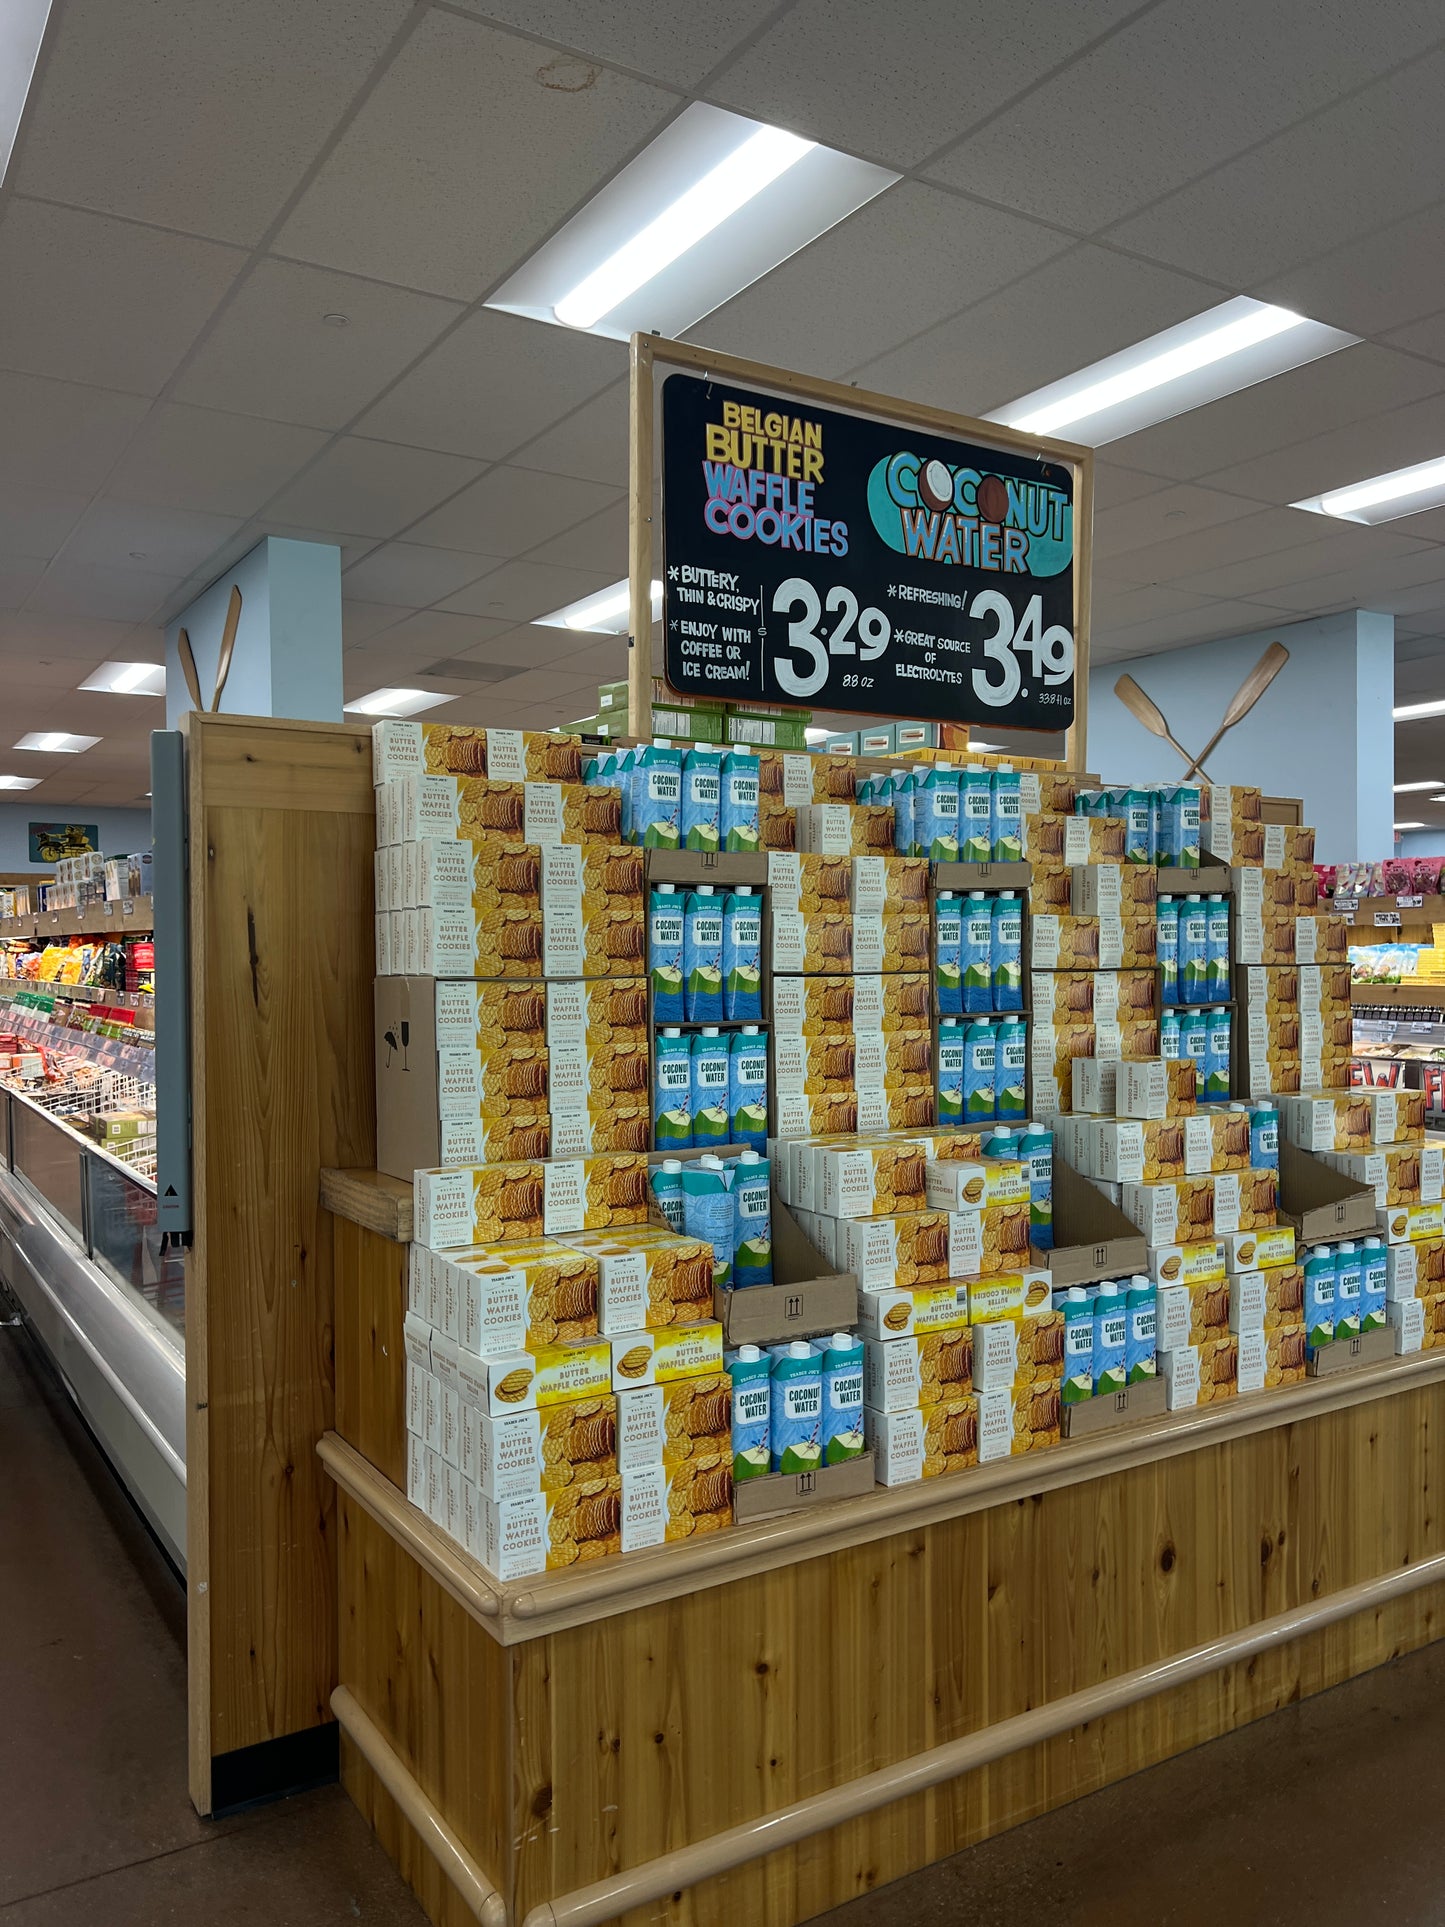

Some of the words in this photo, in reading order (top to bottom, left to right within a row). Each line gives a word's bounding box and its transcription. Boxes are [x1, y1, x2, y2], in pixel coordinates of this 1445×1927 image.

[722, 401, 822, 448] BELGIAN
[705, 422, 825, 484] BUTTER
[702, 460, 816, 518] WAFFLE
[887, 450, 1068, 541] COCONUT
[704, 497, 849, 557] COOKIES
[901, 507, 1029, 574] WATER
[677, 587, 704, 604] THIN
[681, 620, 718, 639] ENJOY
[722, 627, 751, 643] WITH
[681, 640, 722, 658] COFFEE
[726, 646, 741, 660] OR
[938, 638, 971, 652] SOURCE
[925, 652, 936, 662] OF
[683, 662, 700, 677] ICE
[705, 661, 750, 680] CREAM!
[896, 664, 962, 684] ELECTROLYTES
[658, 787, 676, 796] WATER
[699, 791, 717, 799] WATER
[739, 792, 755, 801] WATER
[941, 805, 956, 813] WATER
[661, 931, 679, 940] WATER
[701, 932, 719, 941] WATER
[740, 932, 757, 941] WATER
[668, 1075, 687, 1084] WATER
[706, 1073, 724, 1082] WATER
[746, 1070, 764, 1080] WATER
[748, 1201, 766, 1213] WATER
[1075, 1339, 1091, 1349] WATER
[840, 1390, 860, 1403] WATER
[745, 1404, 766, 1418] WATER
[794, 1400, 817, 1413] WATER
